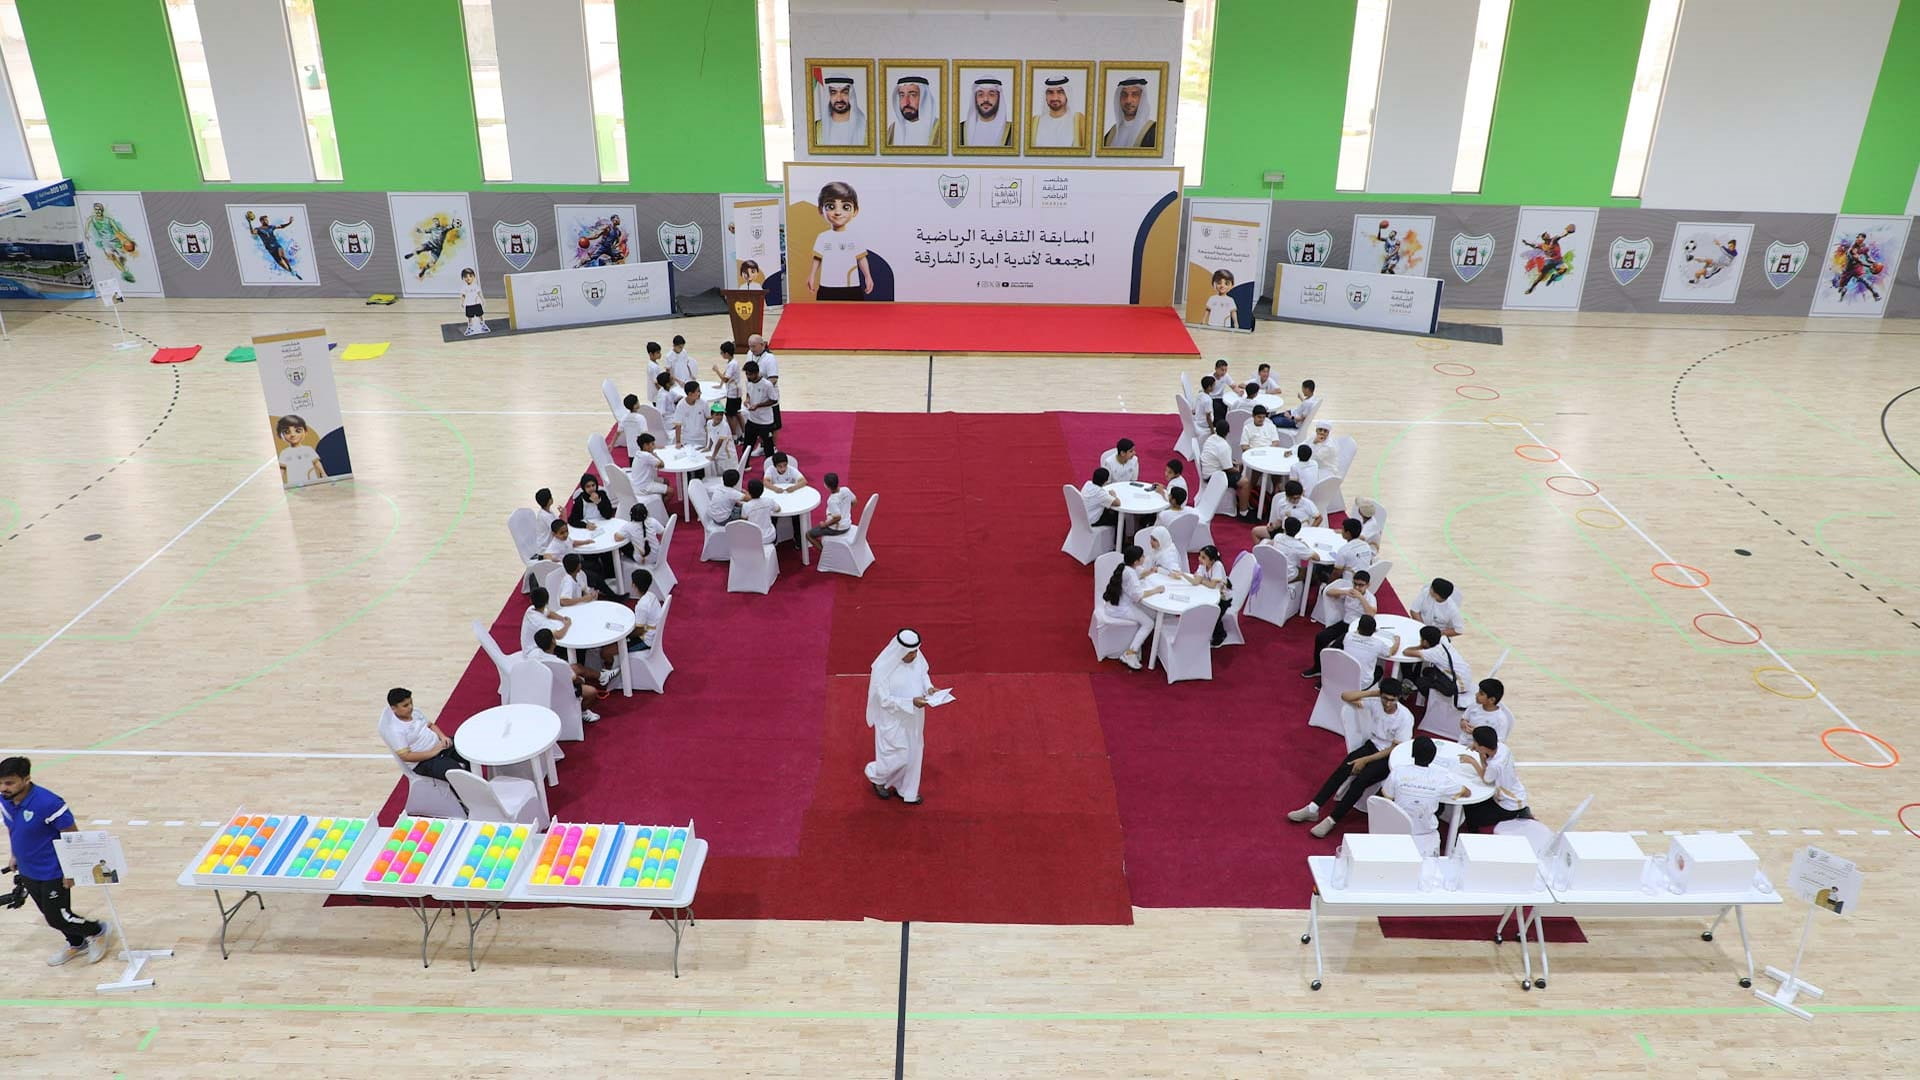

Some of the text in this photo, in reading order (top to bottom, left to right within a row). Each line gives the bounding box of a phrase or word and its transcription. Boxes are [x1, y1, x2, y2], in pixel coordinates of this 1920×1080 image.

[916, 228, 1094, 247] المسابقة الثقافية الرياضية
[914, 251, 1095, 269] المجمعة لأندية إمارة الشارقة
